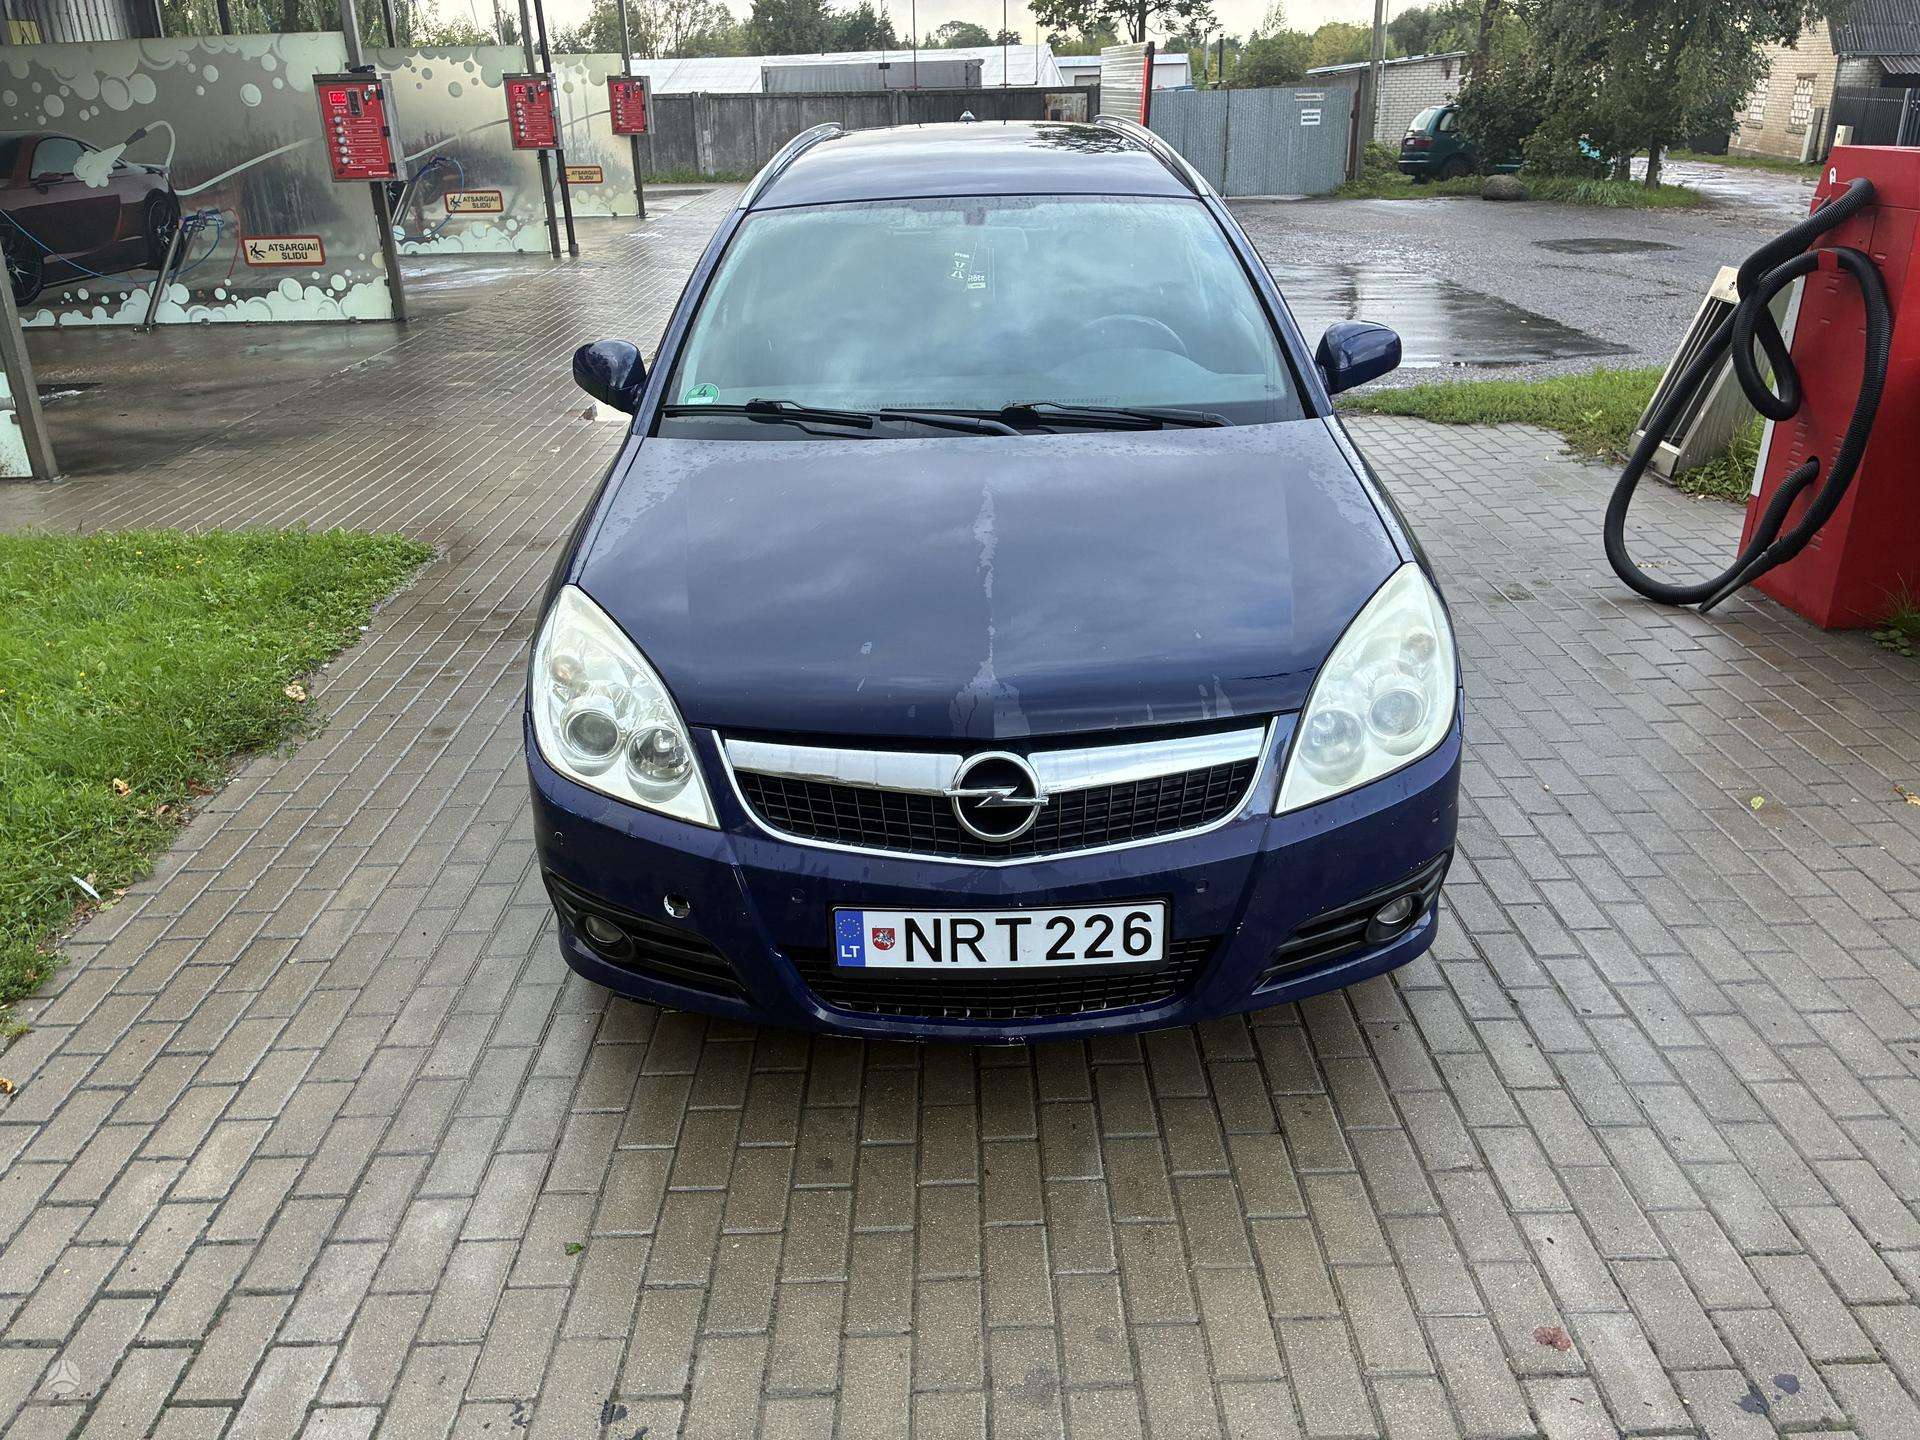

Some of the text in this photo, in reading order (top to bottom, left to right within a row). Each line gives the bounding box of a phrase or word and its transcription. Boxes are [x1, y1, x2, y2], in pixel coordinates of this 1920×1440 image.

[268, 243, 319, 252] ATSARGIAI!
[281, 252, 308, 260] SLIDU
[697, 384, 708, 397] 4
[904, 911, 1153, 962] NRT 226
[841, 945, 860, 958] LT
